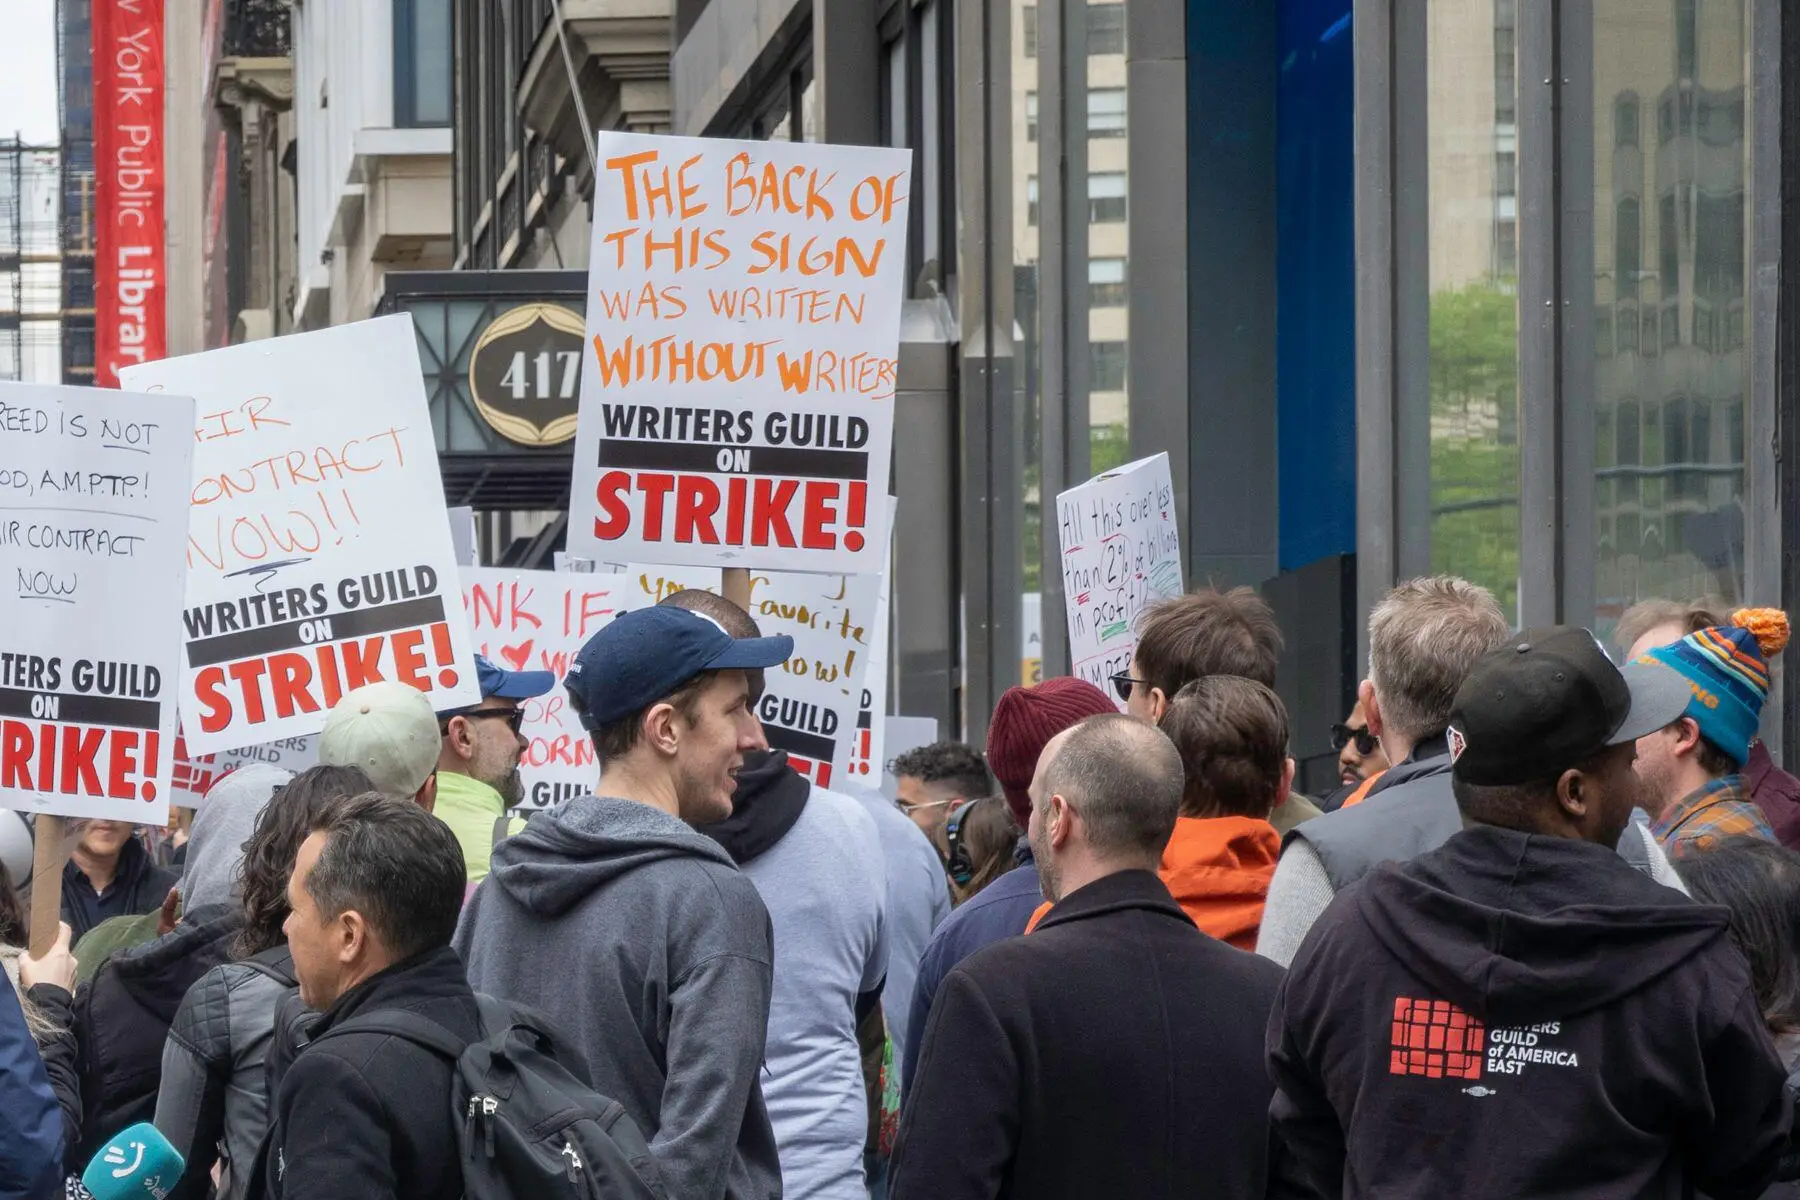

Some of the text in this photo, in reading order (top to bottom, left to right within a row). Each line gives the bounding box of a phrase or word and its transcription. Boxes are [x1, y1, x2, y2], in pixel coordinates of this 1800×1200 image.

[116, 28, 154, 106] York
[116, 125, 154, 226] Public
[606, 150, 908, 225] THE BACK OF
[603, 227, 886, 277] THIS SIGN
[111, 246, 155, 376] Librar
[601, 281, 865, 325] WAS WRITTEN
[500, 351, 580, 399] 417
[593, 333, 898, 399] WITHOUT WRITERS
[59, 411, 87, 437] IS
[101, 418, 159, 445] NOT
[602, 404, 869, 448] WRITERS GUILD
[190, 427, 408, 506] ONTRACT
[716, 448, 750, 473] ON
[594, 471, 867, 552] STRIKE!
[1062, 501, 1085, 550] All
[1091, 484, 1123, 538] this
[1130, 490, 1153, 524] over
[27, 525, 145, 557] CONTRACT
[17, 567, 77, 595] NOW
[1065, 558, 1101, 596] than
[1107, 540, 1129, 584] 2%
[183, 564, 438, 640] WRITERS GUILD
[564, 588, 615, 639] IF
[1071, 607, 1086, 639] in
[298, 618, 334, 645] ON
[72, 659, 161, 699] GUILD
[194, 621, 459, 734] STRIKE!
[30, 695, 60, 720] ON
[760, 693, 838, 736] GUILD
[1488, 1045, 1578, 1067] of AMERICA
[1490, 1029, 1538, 1047] GUILD
[1487, 1058, 1525, 1075] EAST
